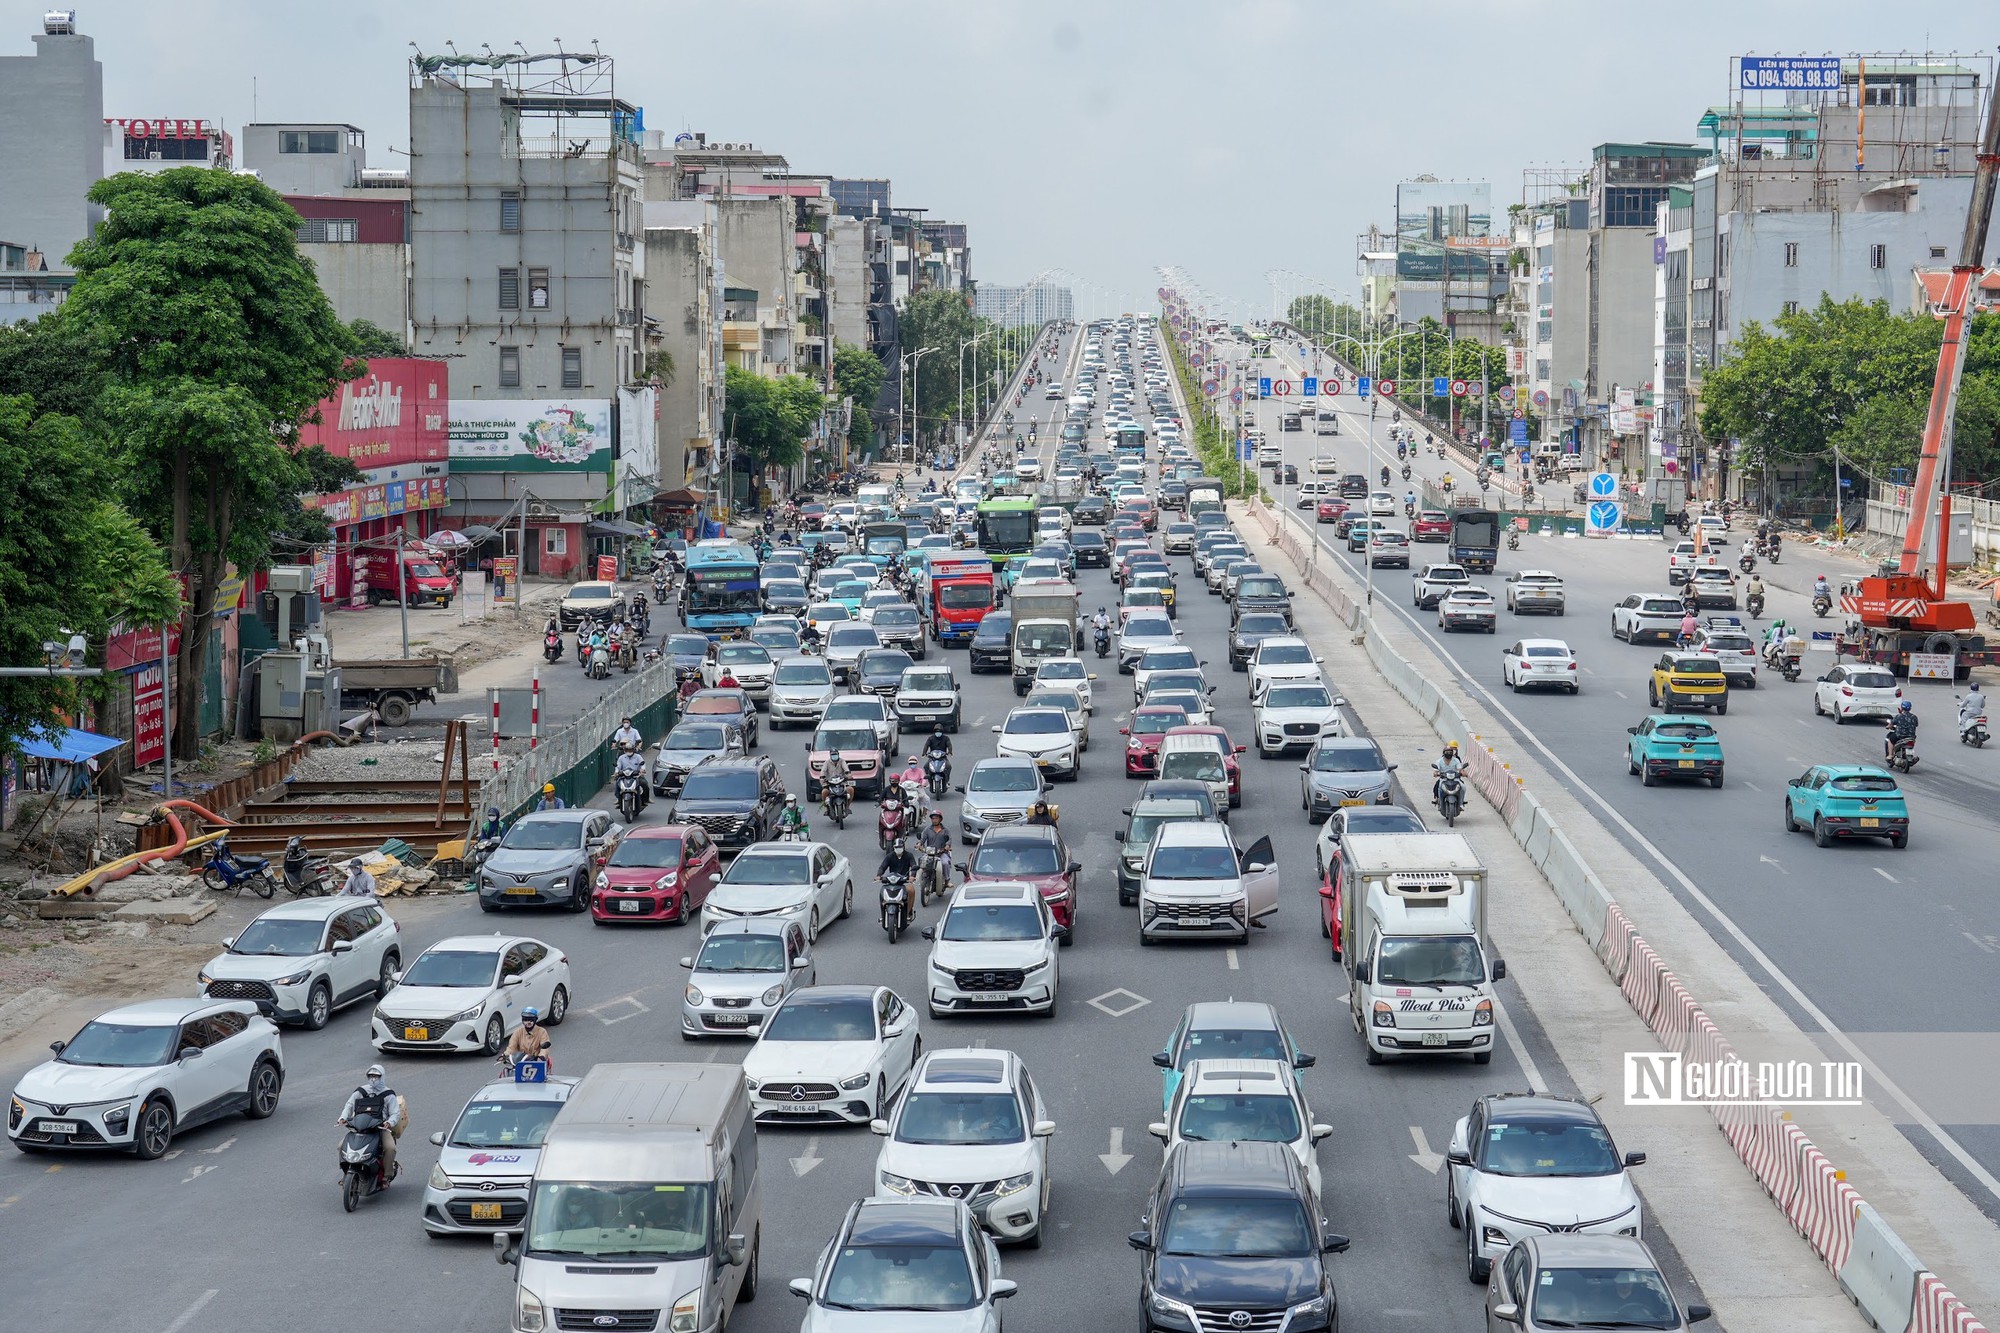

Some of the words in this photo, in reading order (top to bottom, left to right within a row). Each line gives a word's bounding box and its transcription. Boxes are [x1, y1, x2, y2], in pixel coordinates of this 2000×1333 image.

[1759, 59, 1777, 68] LIÊN
[1779, 60, 1789, 69] HỆ
[1791, 59, 1819, 68] QUẢNG
[1821, 60, 1838, 68] CÁO
[1760, 70, 1838, 87] 094.986.98.98
[103, 119, 210, 140] OTEL
[1329, 384, 1336, 392] 60
[1382, 384, 1390, 392] 60
[1455, 384, 1464, 392] 40
[1400, 999, 1434, 1011] Meat
[1438, 998, 1465, 1011] Plus
